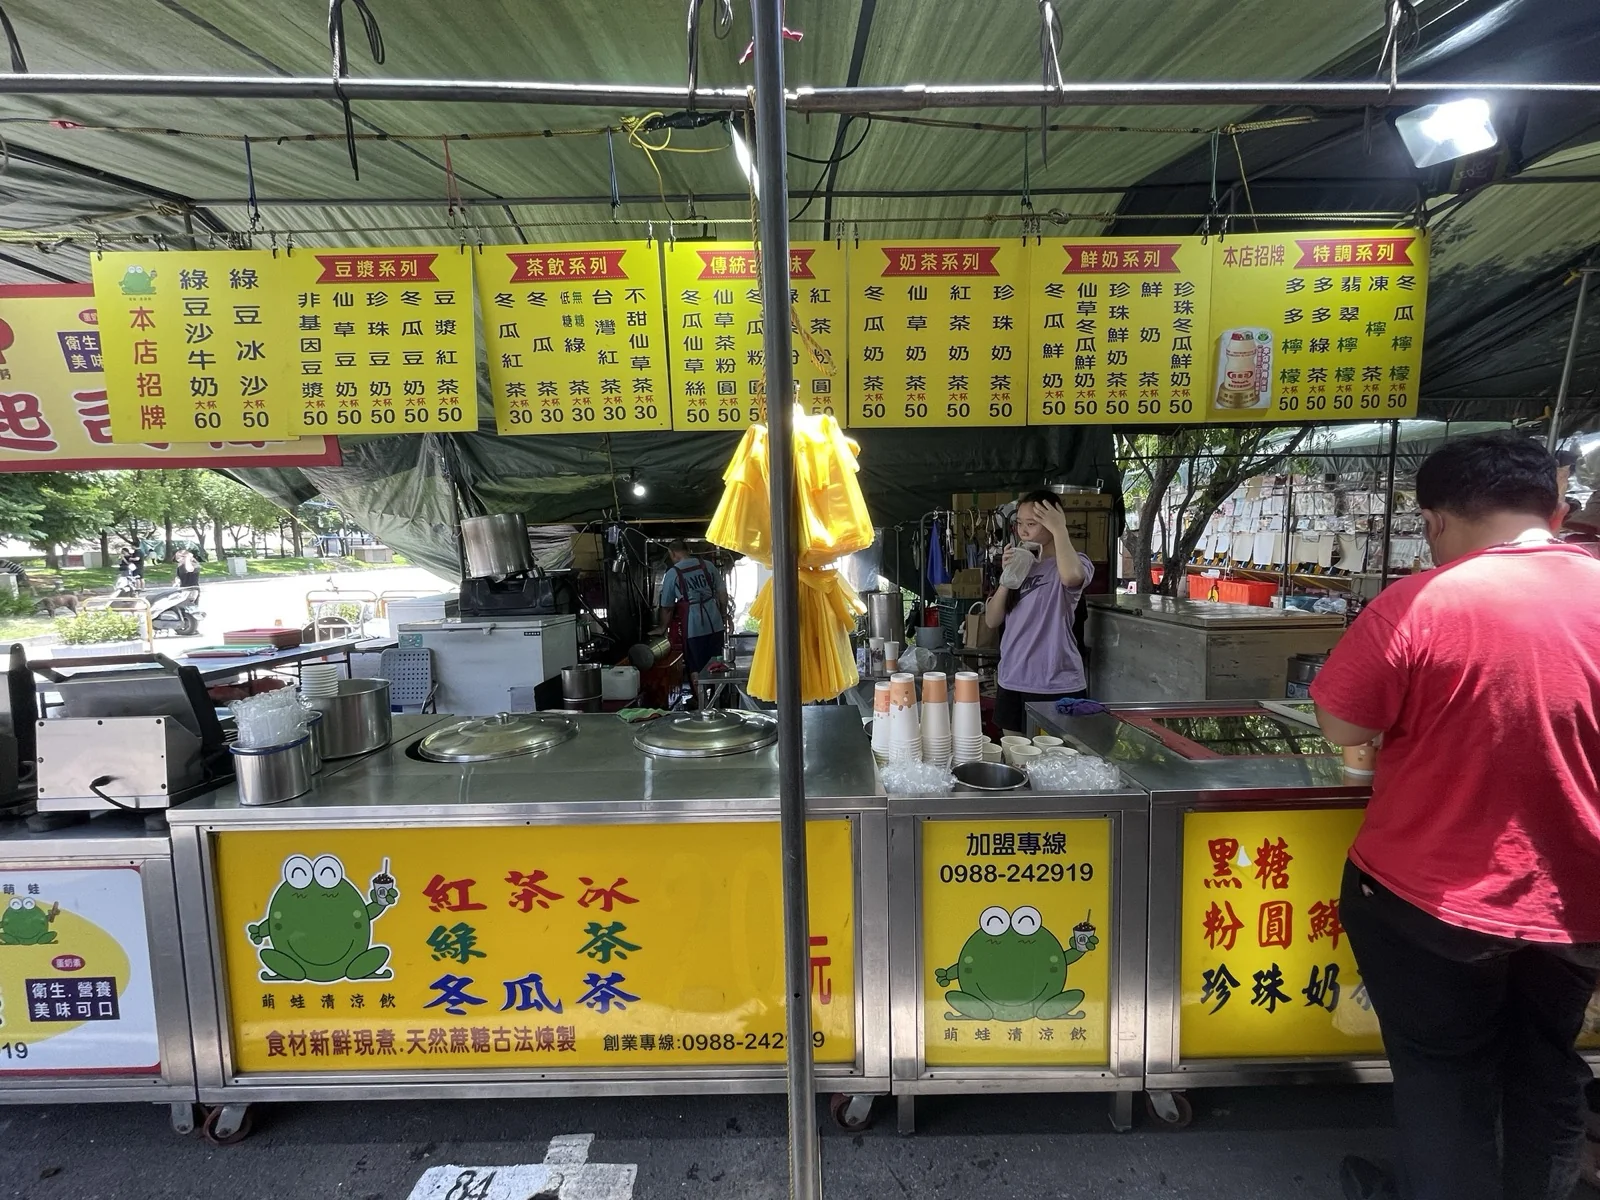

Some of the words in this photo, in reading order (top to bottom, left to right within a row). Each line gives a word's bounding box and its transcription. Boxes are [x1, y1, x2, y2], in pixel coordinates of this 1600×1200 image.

[1081, 250, 1160, 268] 鮮奶系列
[1223, 245, 1285, 267] 本店招牌
[1313, 244, 1394, 262] 特調系列
[335, 260, 417, 277] 豆漿系列
[526, 256, 607, 278] 茶飲系列
[900, 253, 978, 270] 奶茶系列
[180, 270, 218, 397] 綠豆沙牛奶
[230, 269, 268, 396] 綠豆冰沙
[1107, 282, 1130, 387] 珍珠鮮奶茶
[1139, 282, 1162, 387] 鮮奶茶
[1171, 282, 1194, 386] 珍珠冬瓜鮮奶
[1280, 277, 1305, 384] 多多檸檬
[1307, 276, 1333, 383] 多多綠茶
[1335, 276, 1361, 382] 翡翠檸檬
[1362, 276, 1389, 382] 凍檸茶
[1389, 275, 1416, 381] 冬瓜檸檬
[592, 289, 621, 395] 台灣紅茶
[625, 289, 653, 393] 不甜仙草茶
[714, 290, 736, 395] 仙草茶粉圓
[864, 286, 884, 391] 冬瓜奶茶
[906, 286, 927, 390] 仙草奶茶
[948, 285, 971, 390] 紅茶奶茶
[991, 285, 1014, 390] 珍珠奶茶
[1043, 283, 1065, 388] 冬瓜鮮奶
[1075, 283, 1097, 388] 仙草冬瓜鮮奶
[298, 293, 324, 399] 非基因豆漿
[333, 292, 357, 398] 仙草豆奶
[367, 292, 392, 397] 珍珠豆奶
[401, 291, 424, 396] 冬瓜豆奶
[434, 291, 458, 395] 豆漿紅茶
[494, 293, 527, 398] 冬瓜紅茶
[527, 292, 559, 397] 冬瓜茶
[682, 290, 705, 396] 冬瓜仙草絲
[130, 307, 166, 430] 本店招牌
[565, 338, 589, 396] 綠茶
[1043, 390, 1064, 398] 大杯
[1075, 390, 1095, 398] 大杯
[1108, 390, 1127, 398] 大杯
[1172, 389, 1190, 397] 大杯
[1282, 386, 1298, 394] 大杯
[1308, 385, 1325, 393] 大杯
[1336, 385, 1352, 393] 大杯
[1363, 384, 1379, 392] 大杯
[305, 400, 325, 408] 大杯
[337, 399, 359, 408] 大杯
[373, 399, 392, 407] 大杯
[406, 398, 426, 406] 大杯
[439, 397, 458, 405] 大杯
[510, 399, 529, 408] 大杯
[541, 398, 560, 406] 大杯
[573, 397, 591, 405] 大杯
[604, 396, 623, 405] 大杯
[635, 395, 654, 403] 大杯
[689, 398, 707, 406] 大杯
[720, 398, 738, 406] 大杯
[813, 396, 831, 405] 大杯
[864, 393, 883, 401] 大杯
[907, 393, 925, 401] 大杯
[949, 393, 968, 401] 大杯
[992, 393, 1010, 401] 大杯
[1279, 397, 1298, 410] 50
[1307, 396, 1326, 410] 50
[1334, 395, 1353, 409] 50
[1361, 395, 1380, 408] 50
[1388, 394, 1406, 408] 50
[195, 401, 217, 409] 大杯
[243, 400, 265, 409] 大杯
[863, 403, 885, 418] 50
[905, 403, 927, 417] 50
[947, 403, 970, 417] 50
[990, 403, 1012, 417] 50
[1043, 401, 1065, 415] 50
[1075, 400, 1097, 414] 50
[1106, 400, 1129, 414] 50
[1138, 400, 1160, 414] 50
[1170, 400, 1192, 413] 50
[304, 411, 327, 425] 50
[338, 410, 361, 424] 50
[371, 409, 395, 423] 50
[405, 408, 428, 422] 50
[438, 407, 462, 422] 50
[510, 409, 532, 424] 30
[541, 409, 563, 422] 30
[572, 408, 594, 421] 30
[603, 406, 626, 420] 30
[635, 405, 657, 419] 30
[687, 408, 709, 422] 50
[719, 408, 740, 422] 50
[195, 413, 221, 428] 60
[243, 412, 269, 427] 50
[966, 832, 1068, 856] 加盟專線
[1204, 837, 1294, 889] 黑糖
[940, 863, 1093, 883] 0988-242919
[3, 884, 40, 894] 萌蛙
[422, 870, 639, 913] 紅茶冰
[426, 921, 642, 964] 綠茶
[423, 972, 640, 1015] 冬瓜茶
[1200, 963, 1372, 1015] 珍珠奶
[262, 993, 395, 1009] 萌蛙清涼飲
[34, 1002, 112, 1018] 美味可口
[944, 1027, 1086, 1041] 萌蛙清涼飲
